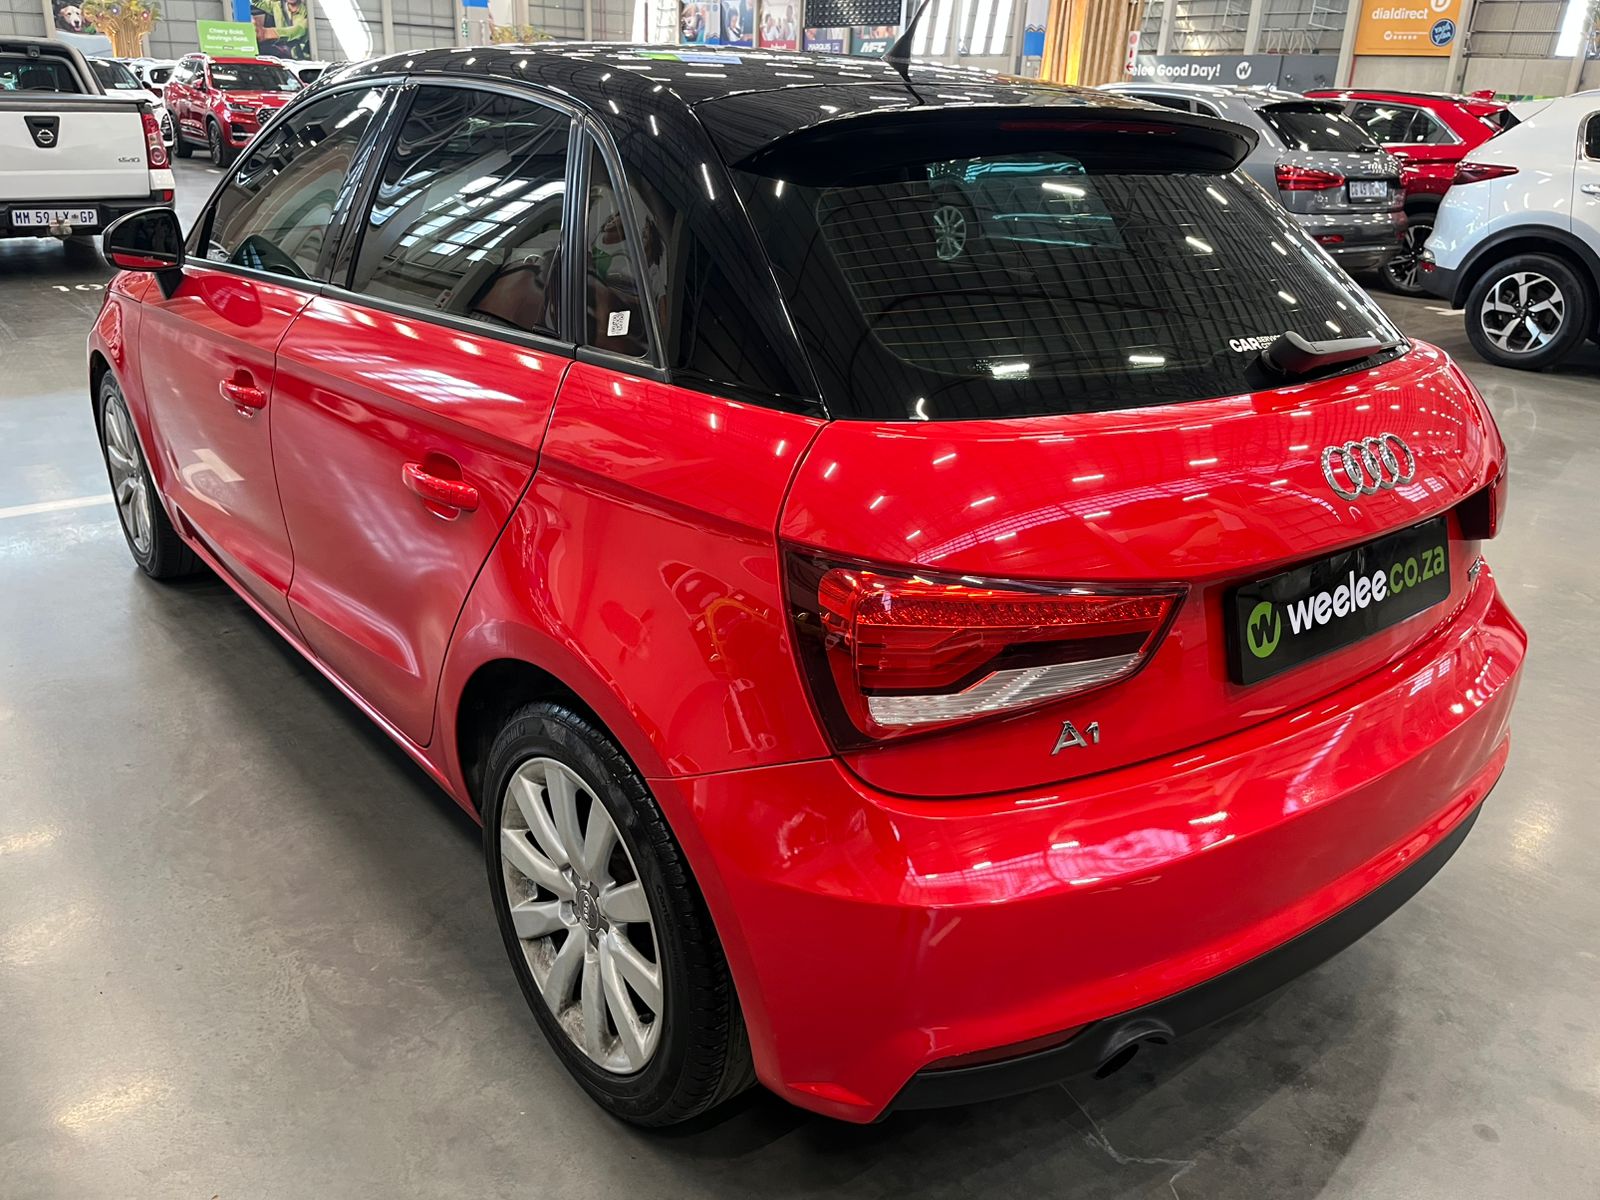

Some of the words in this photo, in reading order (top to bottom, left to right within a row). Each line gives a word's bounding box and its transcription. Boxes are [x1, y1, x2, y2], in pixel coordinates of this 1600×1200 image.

[1372, 8, 1428, 19] dialdirect
[860, 42, 887, 52] MFC
[1132, 63, 1155, 76] elee
[1157, 63, 1189, 76] Good
[1190, 63, 1220, 80] Day!
[36, 212, 49, 224] 59
[80, 211, 94, 223] GP
[1229, 337, 1262, 352] CAR
[1287, 545, 1445, 635] weelee.co.za
[1051, 720, 1100, 755] A1
